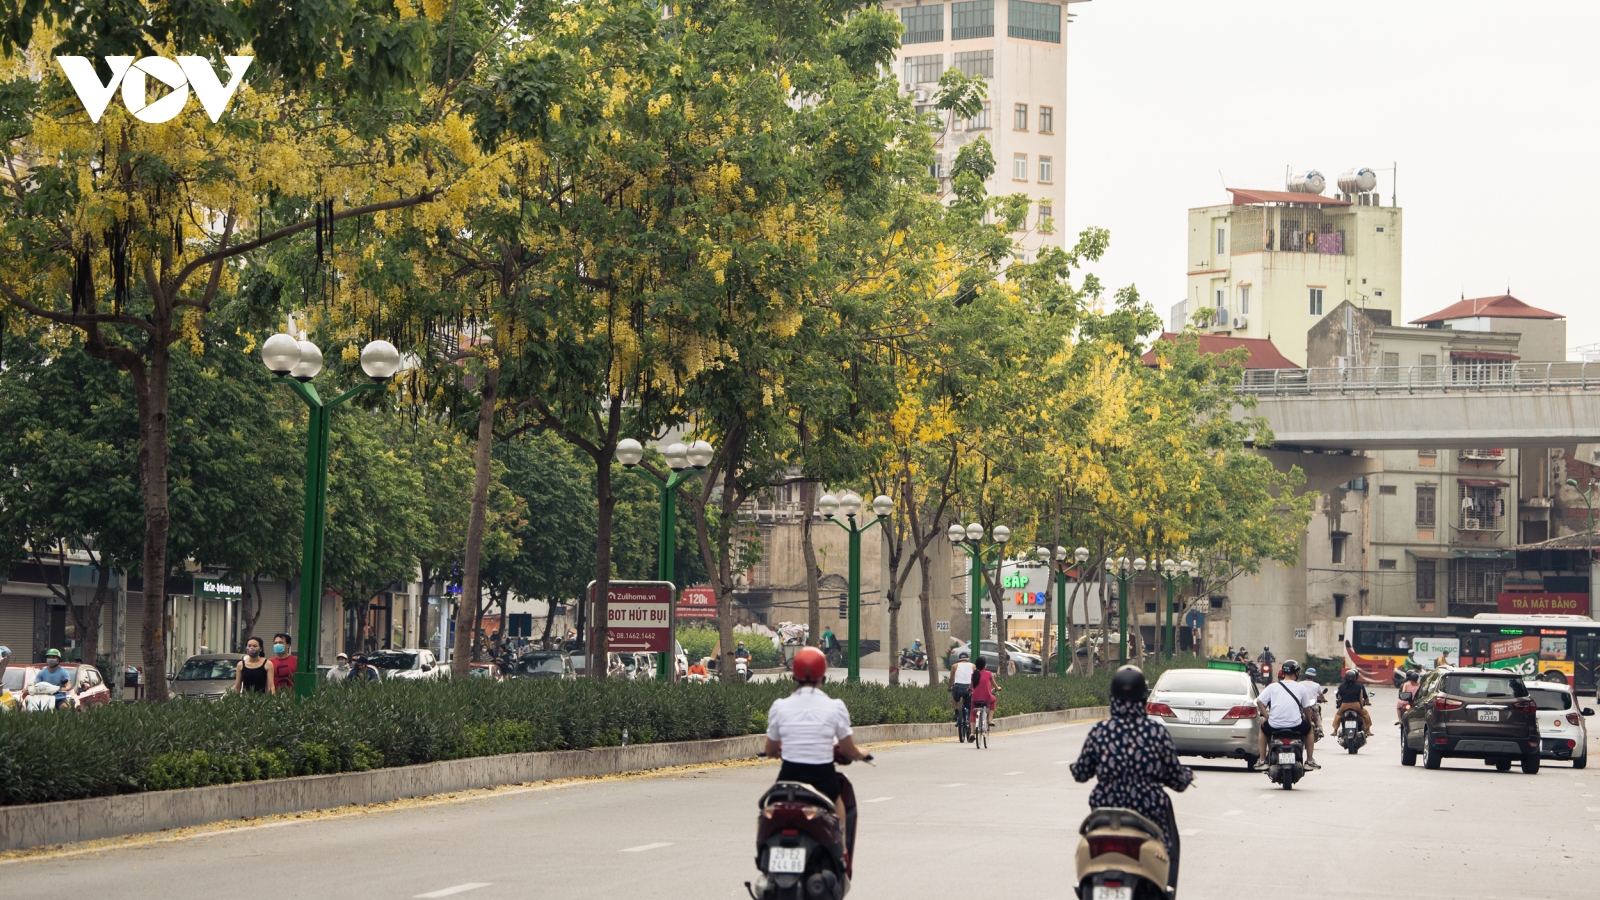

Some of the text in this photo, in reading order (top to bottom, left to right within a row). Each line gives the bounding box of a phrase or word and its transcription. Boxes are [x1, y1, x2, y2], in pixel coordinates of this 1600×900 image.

[1015, 591, 1045, 605] KIDS
[1512, 595, 1577, 610] TRẢ MẶT BẰNG
[629, 607, 648, 621] HÚT
[650, 609, 667, 623] BỤI
